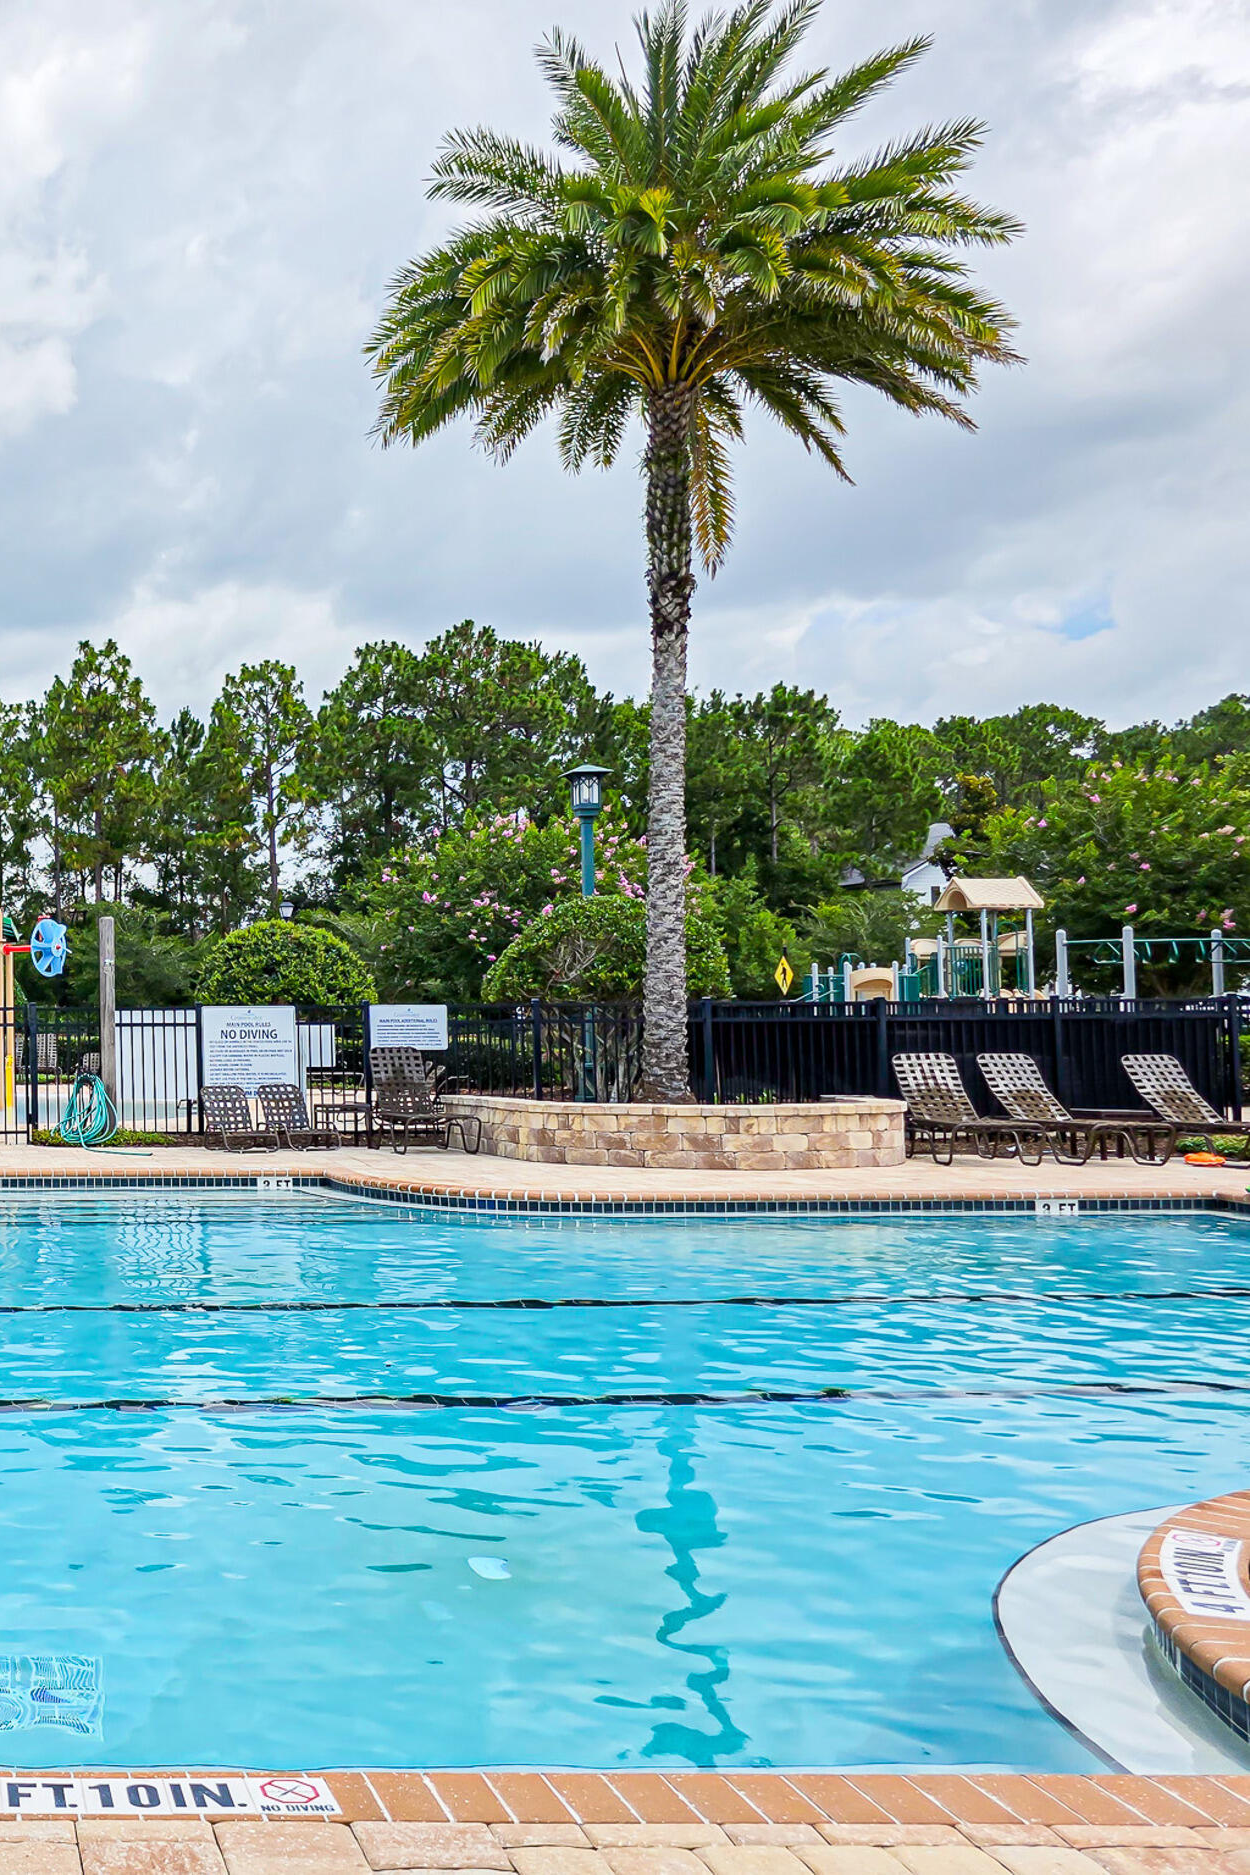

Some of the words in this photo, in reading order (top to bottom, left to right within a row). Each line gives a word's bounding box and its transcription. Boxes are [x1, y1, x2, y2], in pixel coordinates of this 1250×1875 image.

[220, 1029, 237, 1039] NO
[239, 1029, 278, 1039] DIVING
[260, 1804, 281, 1812] NO
[285, 1804, 335, 1812] DIVING
